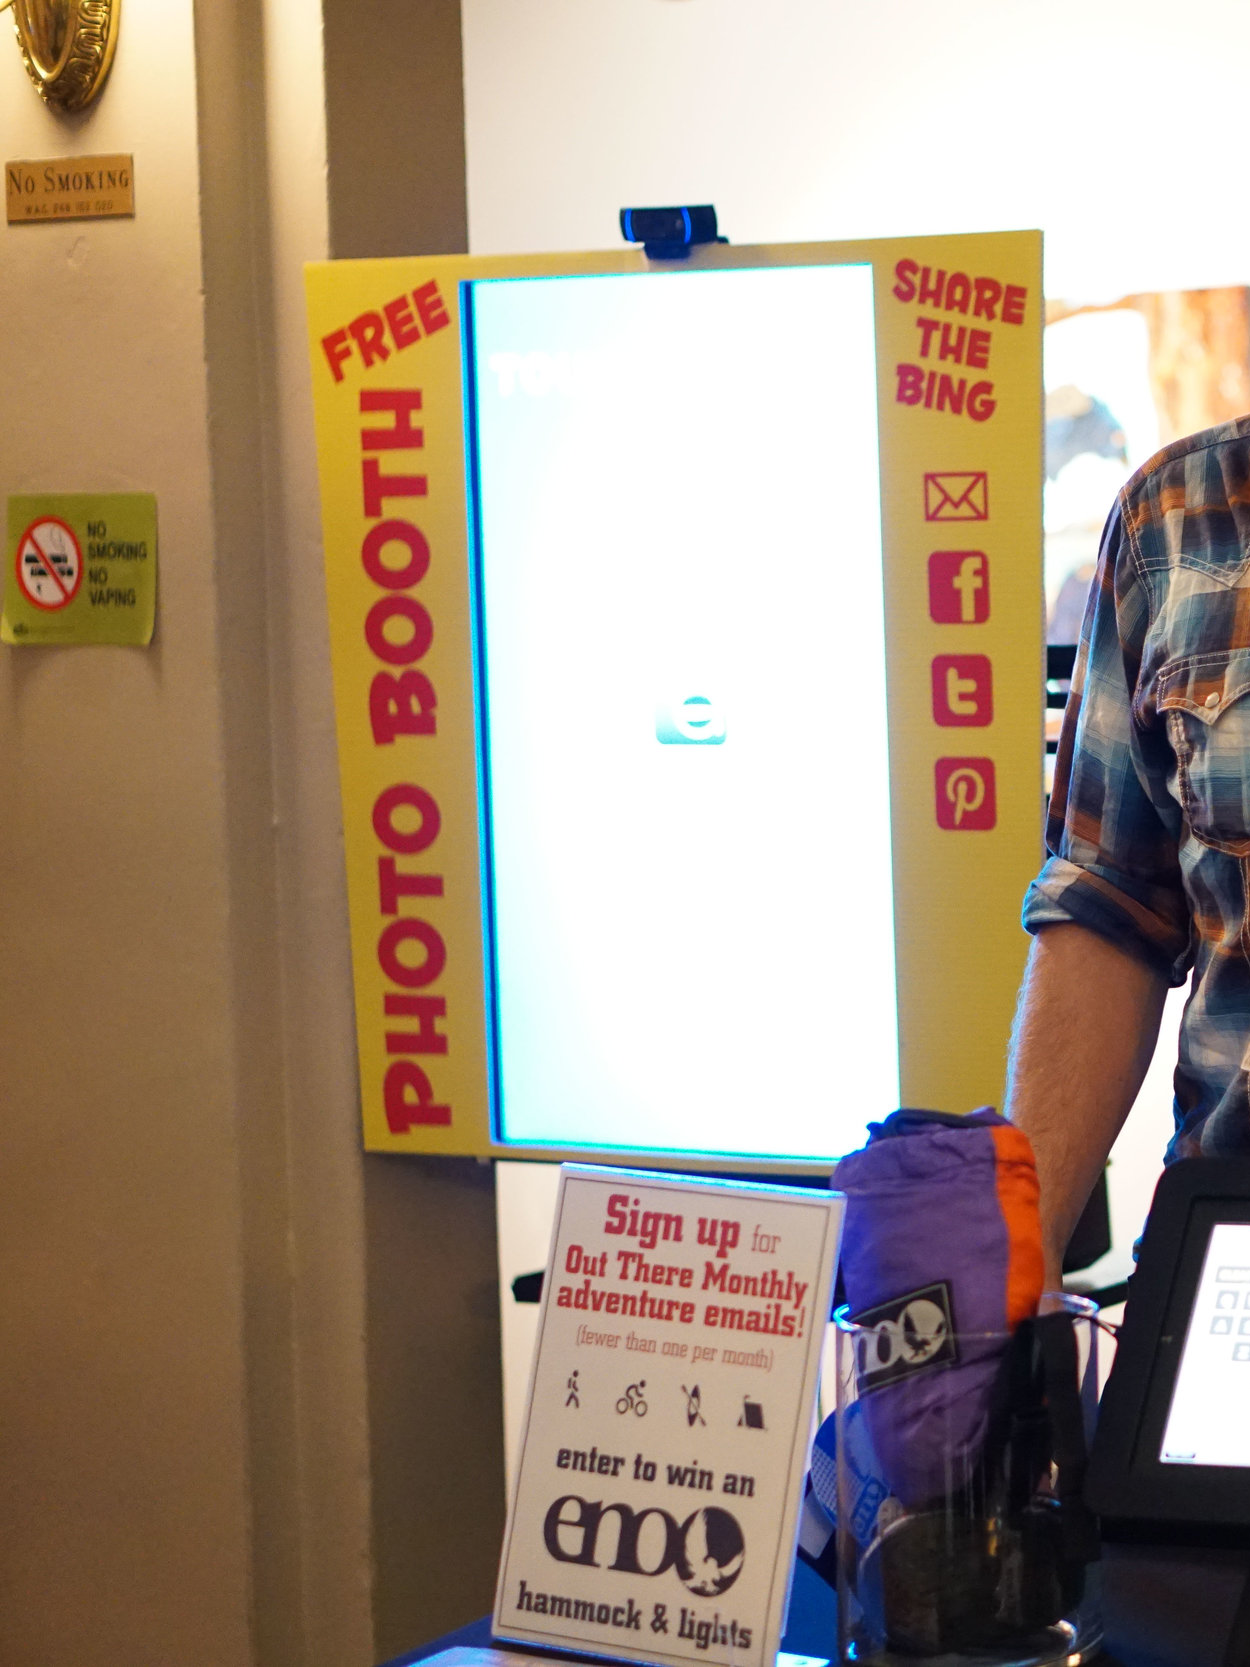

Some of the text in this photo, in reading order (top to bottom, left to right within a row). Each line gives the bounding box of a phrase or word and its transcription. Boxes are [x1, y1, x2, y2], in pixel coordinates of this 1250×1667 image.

[44, 166, 129, 193] SMOKING
[892, 258, 1028, 327] SHARE
[320, 278, 451, 385] FREE
[916, 316, 992, 370] THE
[896, 362, 997, 422] BING
[87, 520, 107, 538] NO
[87, 540, 147, 561] SMOKING
[88, 566, 108, 584] NO
[89, 588, 136, 608] VAPING
[359, 388, 452, 1135] PHOTO BOOTH
[604, 1193, 781, 1258] Sign up for
[565, 1244, 809, 1310] Out There Monthly
[556, 1279, 806, 1339] adventure emails!
[575, 1324, 775, 1373] (fewer than one per month)
[556, 1446, 756, 1498] enter to win an
[516, 1580, 753, 1650] hammock & lights
